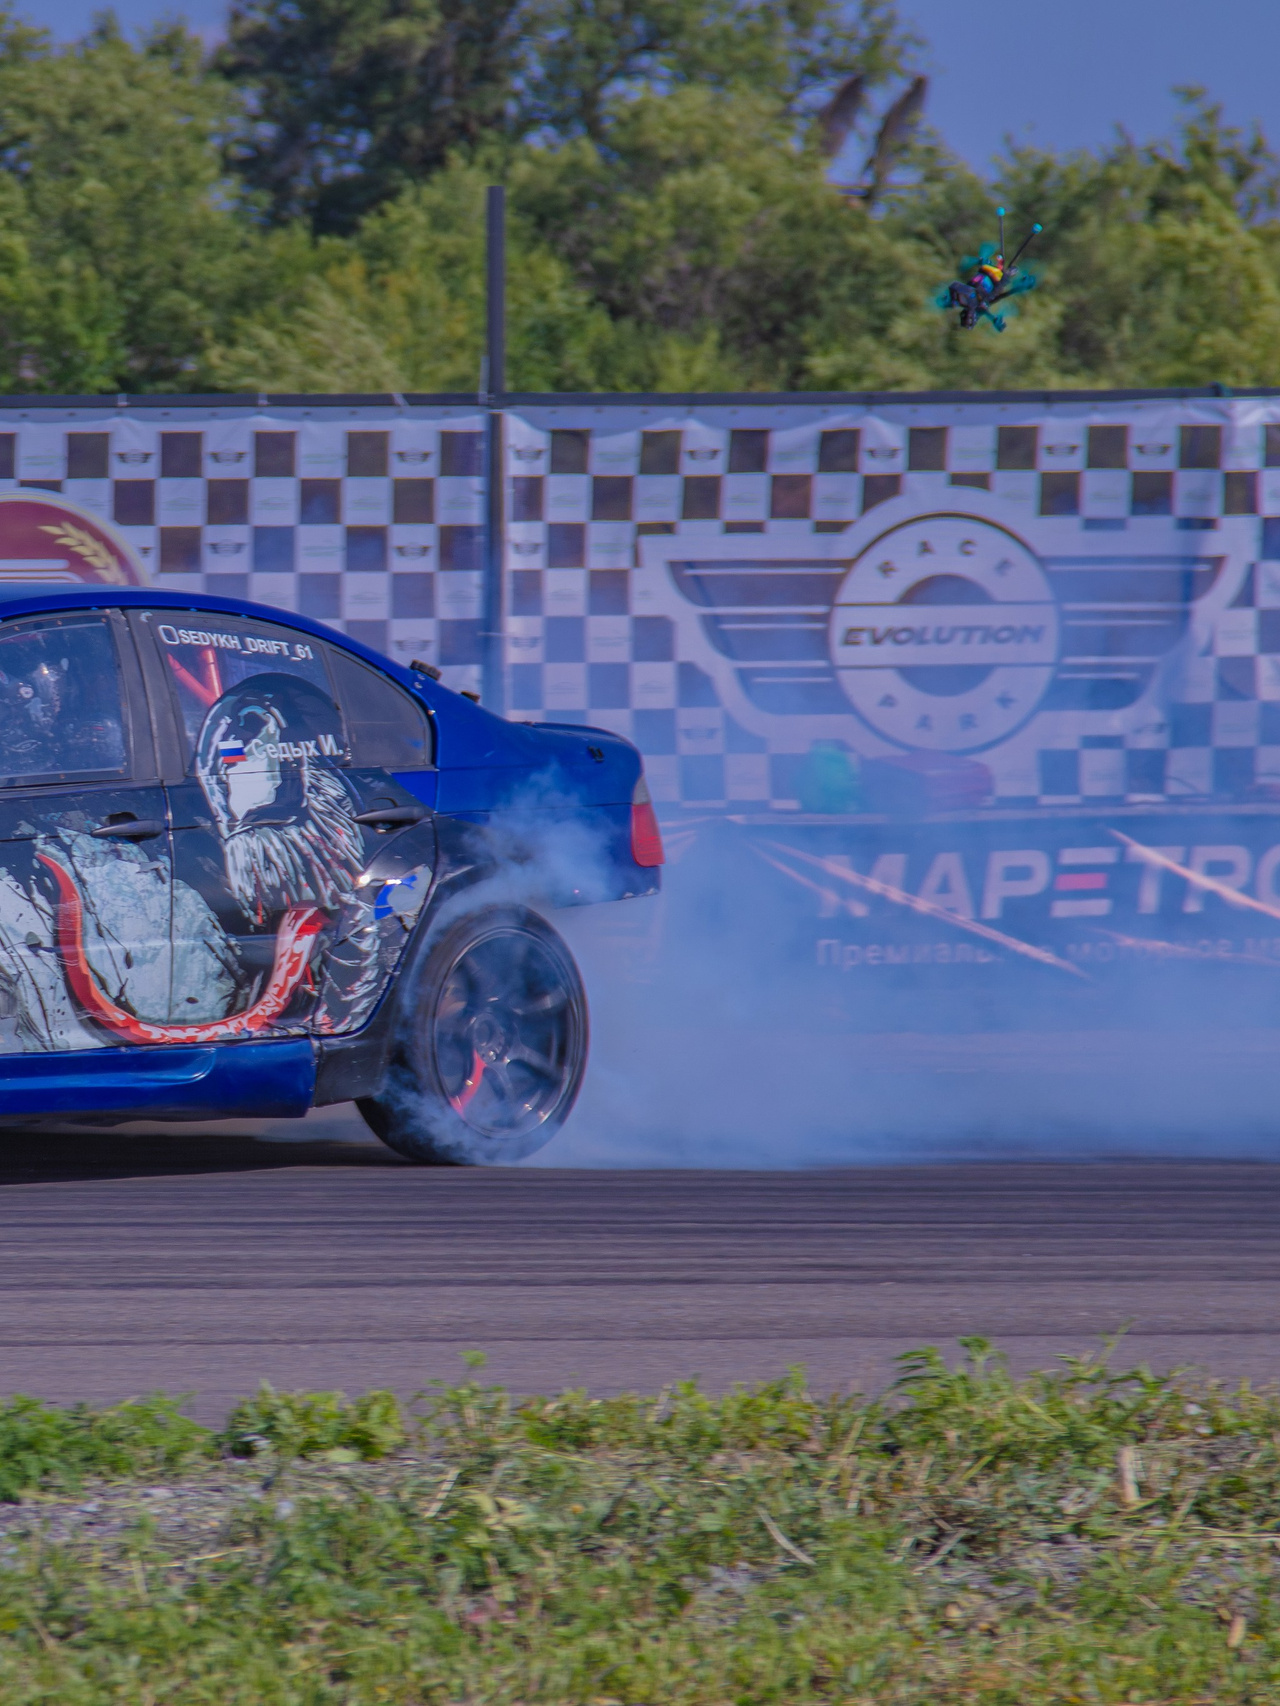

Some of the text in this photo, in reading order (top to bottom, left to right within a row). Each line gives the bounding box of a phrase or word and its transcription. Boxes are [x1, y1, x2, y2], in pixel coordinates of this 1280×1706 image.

[178, 628, 314, 662] SEDYKH_DRIFT_61
[840, 624, 1046, 646] EVOLUTION
[251, 737, 321, 762] Седых
